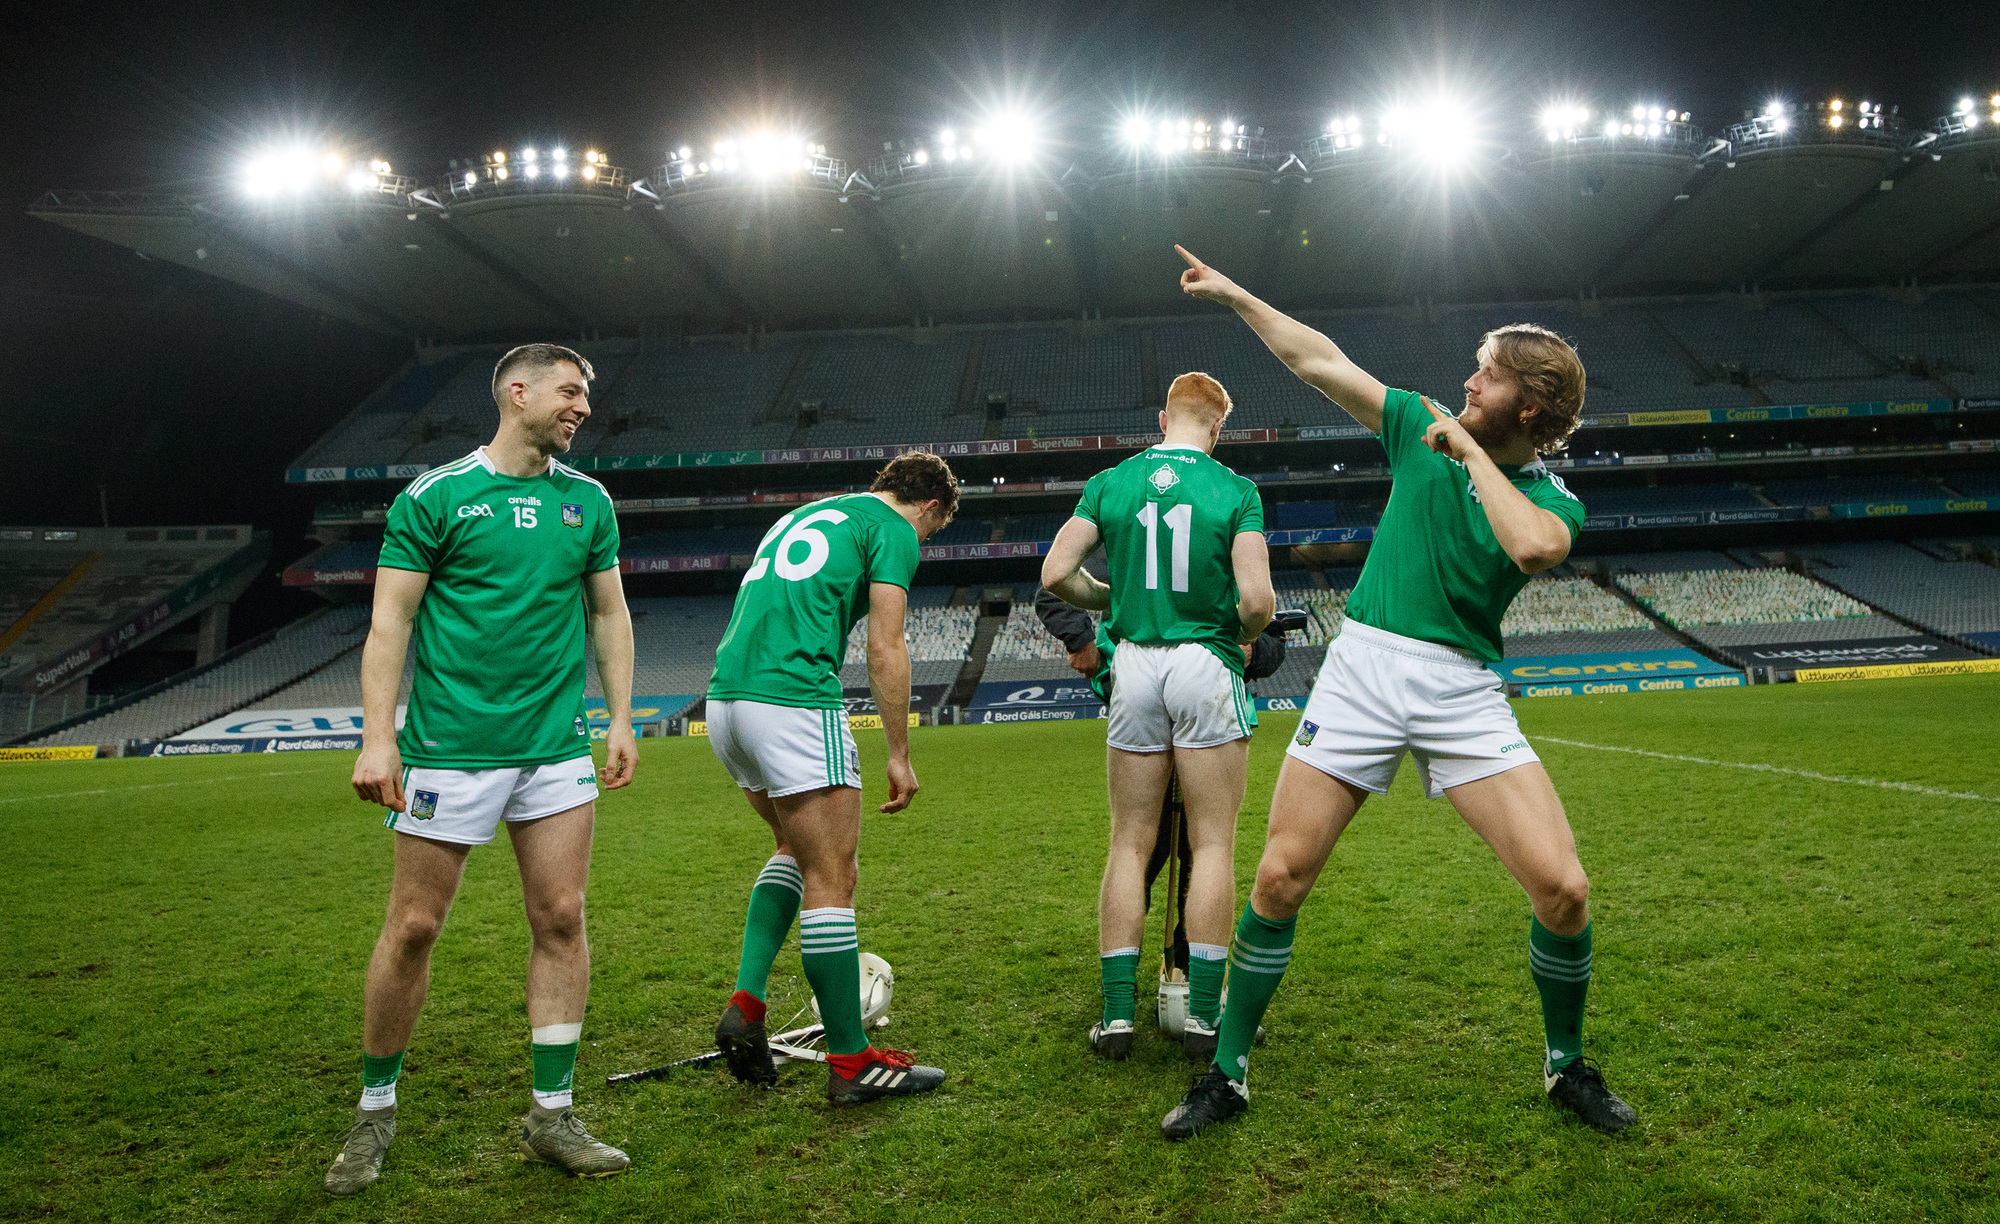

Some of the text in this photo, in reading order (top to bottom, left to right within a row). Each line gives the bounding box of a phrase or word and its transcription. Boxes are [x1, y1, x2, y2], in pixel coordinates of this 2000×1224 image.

[1806, 405, 1848, 417] Centra
[1887, 401, 1929, 413] Centra
[1726, 408, 1769, 421] Centra
[1301, 427, 1372, 438] GAA MUSEUM
[949, 444, 968, 454] AIB
[991, 442, 1010, 452] AIB
[1032, 437, 1083, 450] SuperValu
[780, 451, 800, 461] AIB
[822, 450, 842, 460] AIB
[865, 448, 885, 458] AIB
[1865, 503, 1908, 515] Centra
[1945, 499, 1988, 511] Centra
[513, 506, 538, 529] 15
[1673, 515, 1698, 525] Energy
[1754, 511, 1779, 521] Energy
[1590, 518, 1616, 527] Energy
[740, 508, 849, 587] 26
[969, 546, 989, 556] AIB
[1011, 545, 1031, 555] AIB
[1136, 501, 1193, 593] 11
[927, 548, 946, 558] AIB
[650, 560, 669, 570] AIB
[692, 558, 711, 568] AIB
[313, 570, 365, 583] SuperValu
[35, 649, 91, 688] SuperValu
[1512, 660, 1698, 677] Centra
[1800, 666, 1905, 682] Littlewoods Ireland
[1907, 663, 1974, 676] Littlewoods
[1527, 676, 1740, 697] Centra Centra Centra Centra
[995, 712, 1016, 721] Bord
[1042, 710, 1076, 721] Energy
[164, 744, 189, 754] Bord
[210, 743, 245, 754] Energy
[277, 740, 301, 750] Bord
[323, 739, 359, 750] Energy
